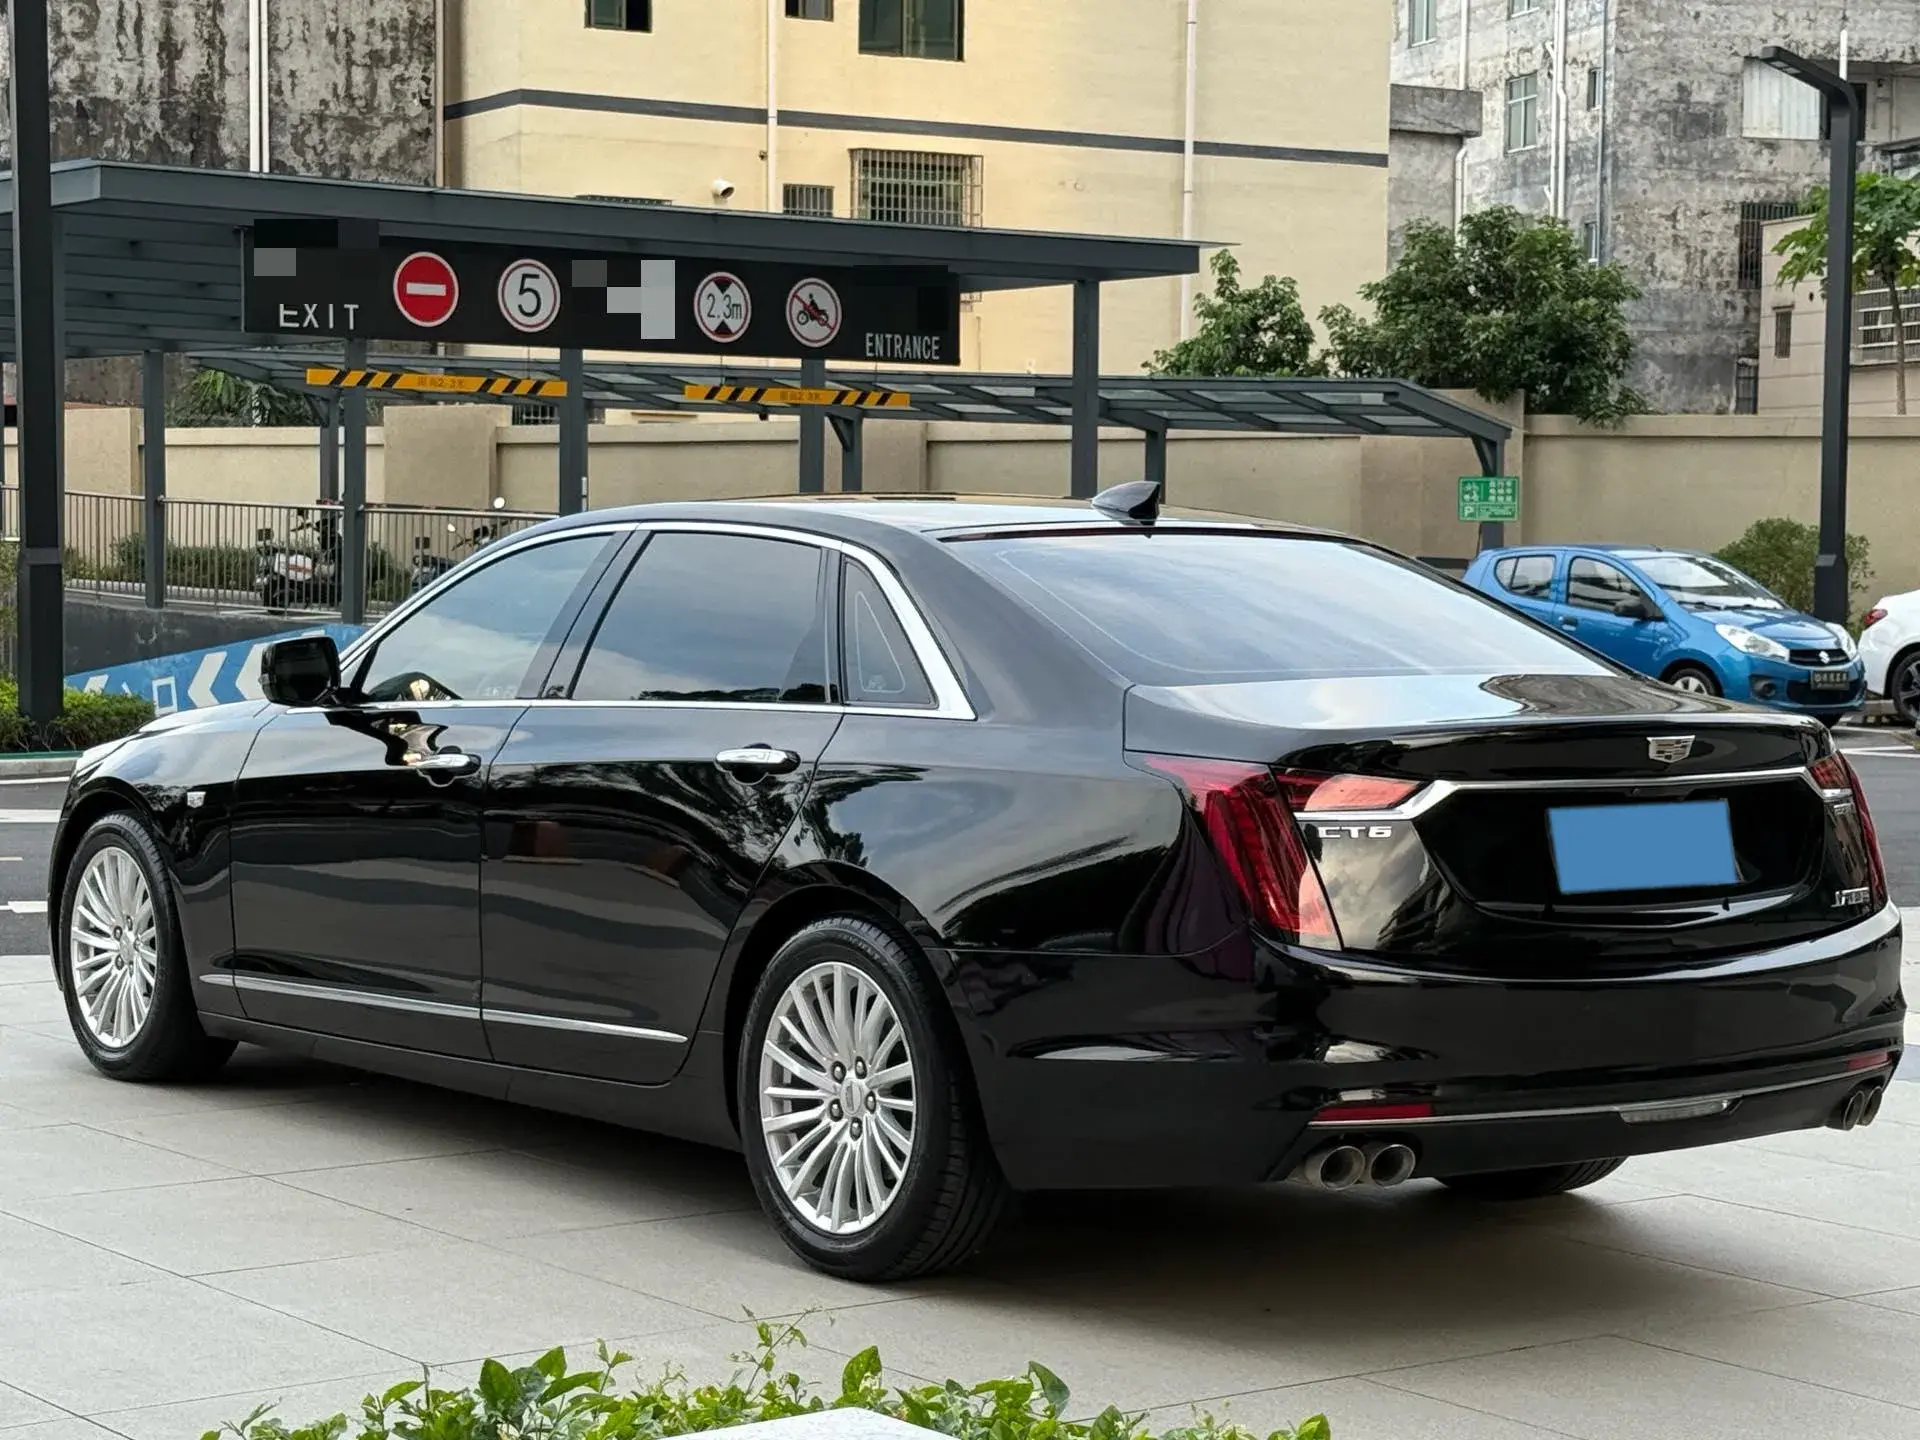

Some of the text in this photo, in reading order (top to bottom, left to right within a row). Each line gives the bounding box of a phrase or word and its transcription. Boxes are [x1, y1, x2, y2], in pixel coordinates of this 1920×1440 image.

[517, 273, 542, 318] 5
[706, 292, 743, 320] 2.3m
[279, 303, 360, 330] EXIT
[865, 332, 941, 360] ENTRANCE
[1317, 826, 1393, 839] CT6
